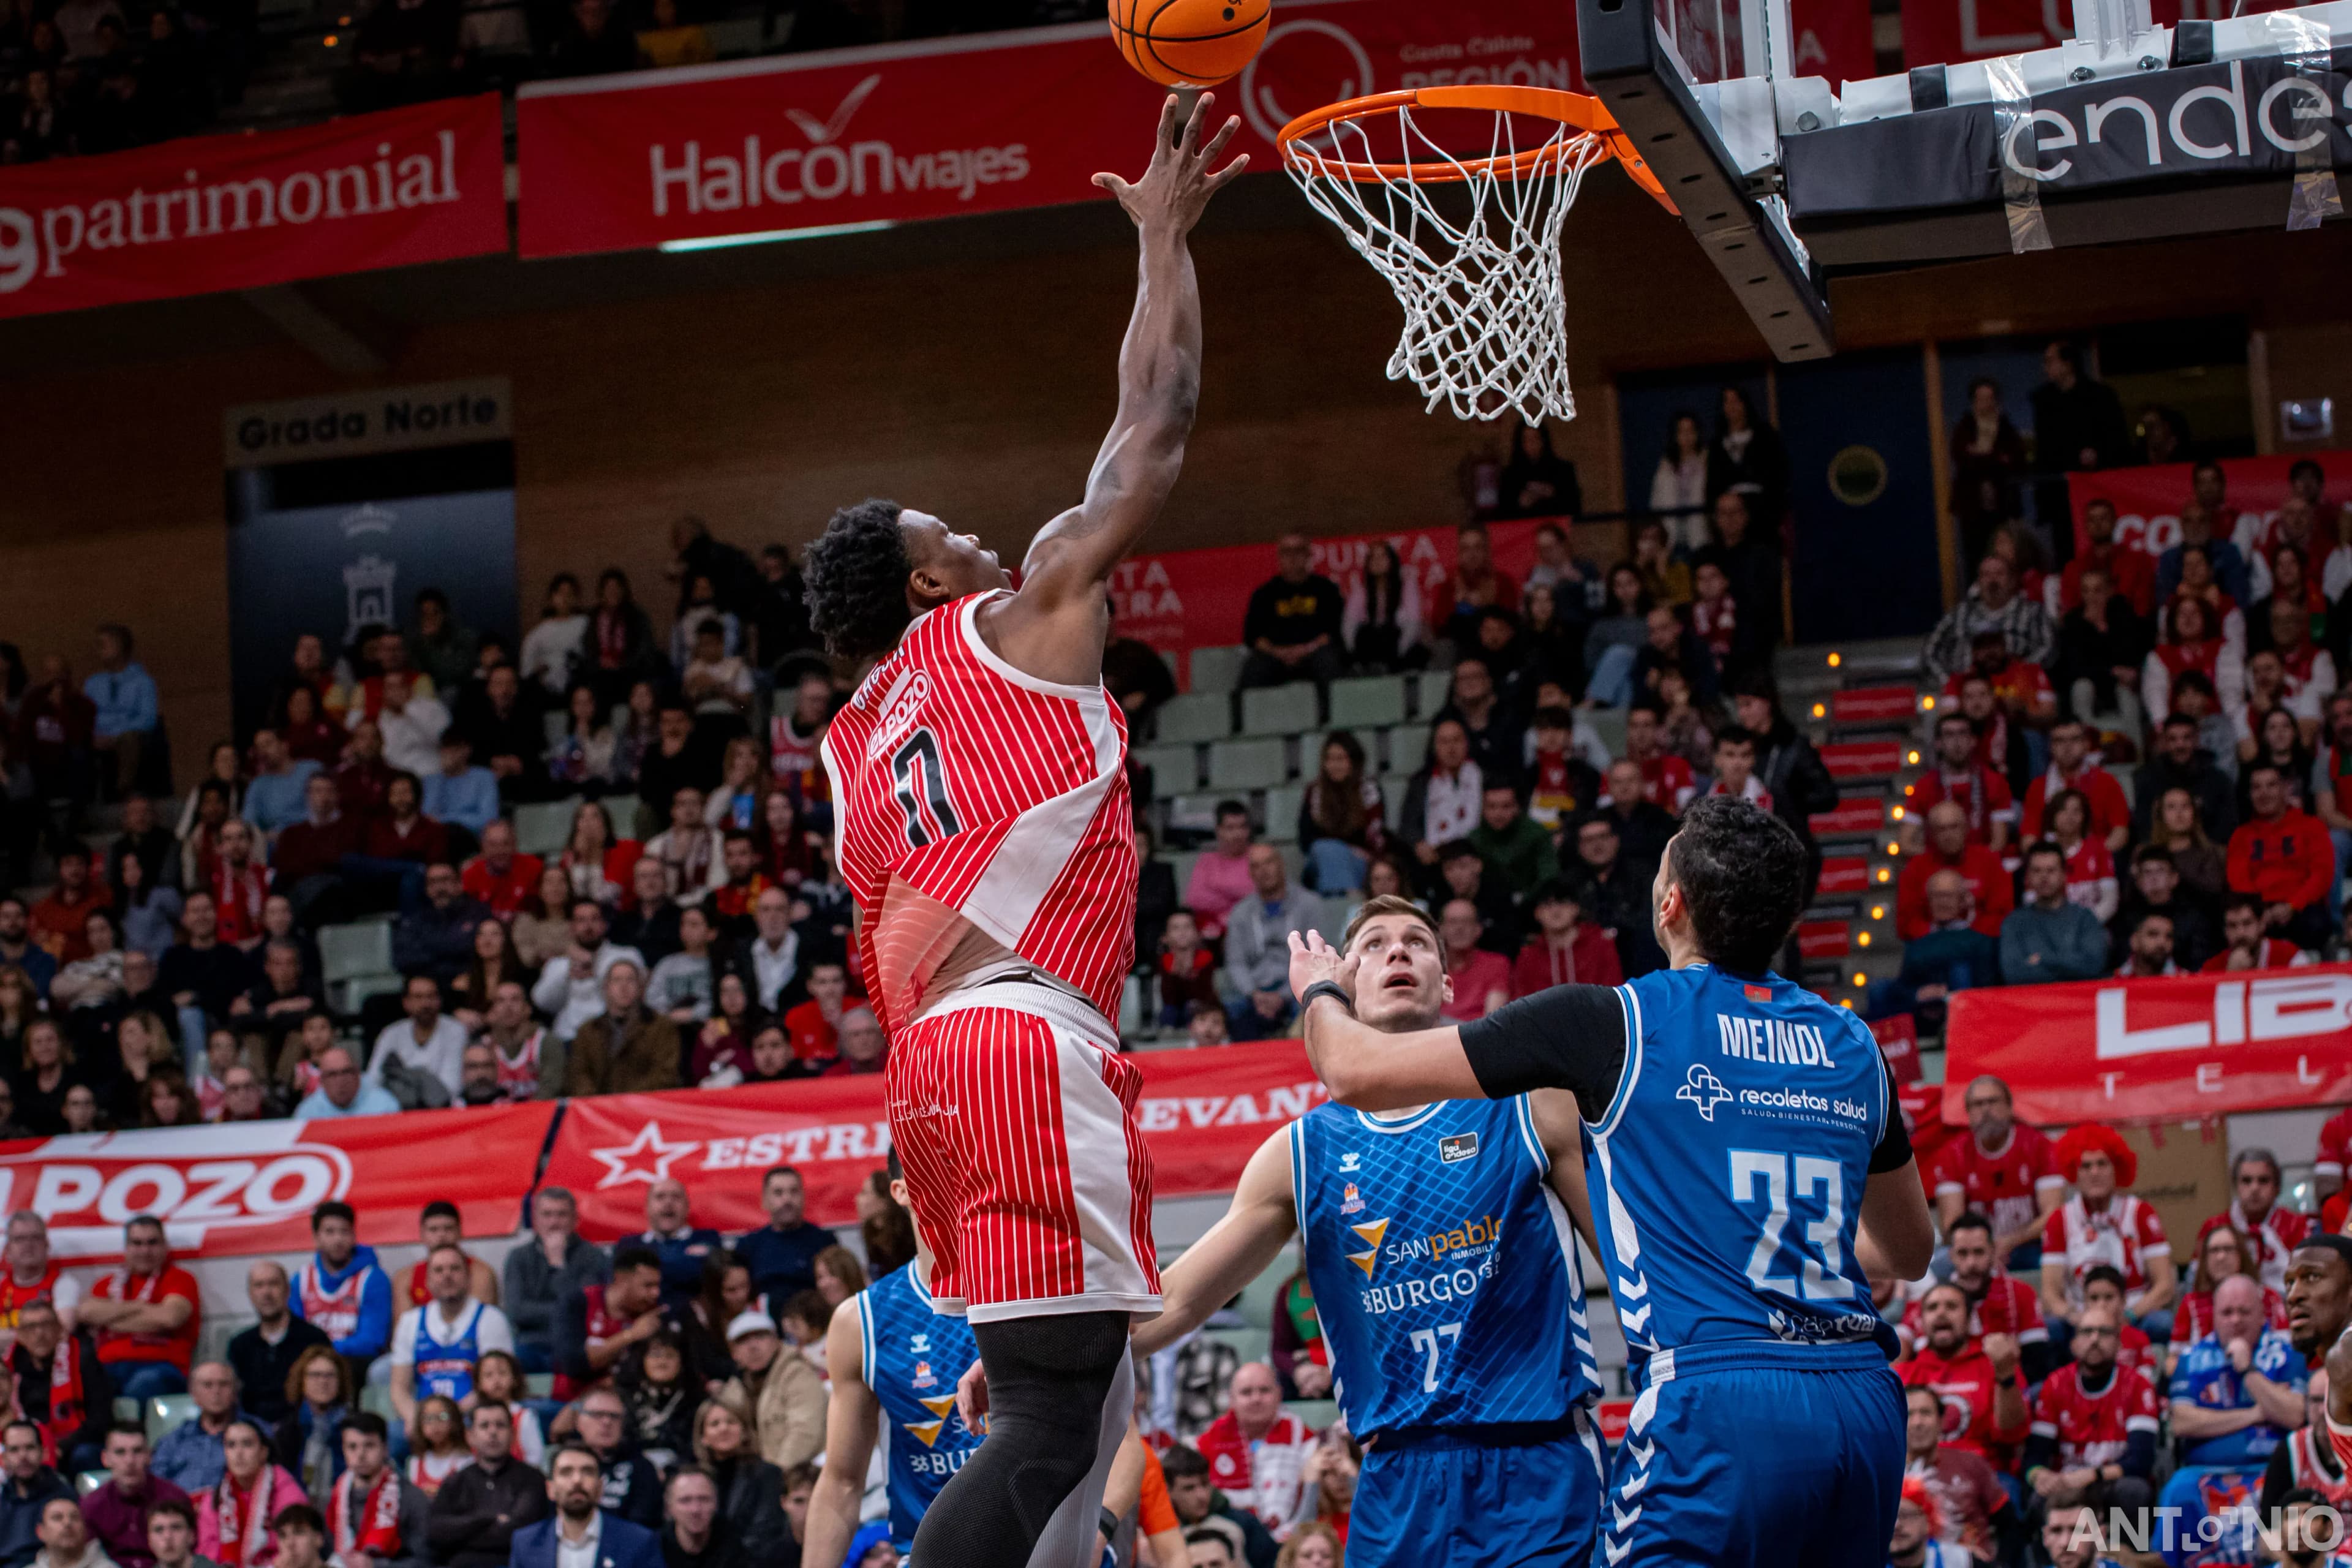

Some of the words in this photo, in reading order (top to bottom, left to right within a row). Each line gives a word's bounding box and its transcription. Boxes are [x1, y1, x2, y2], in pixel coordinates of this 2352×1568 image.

[238, 408, 366, 451] Grada
[383, 393, 498, 432] Norte
[1717, 1013, 1835, 1069] MEINDL
[1133, 1080, 1327, 1133] EVAN
[1740, 1087, 1829, 1112] recoletas
[1833, 1097, 1867, 1121] salud
[1445, 1147, 1476, 1159] endesa
[1727, 1148, 1856, 1302] 23
